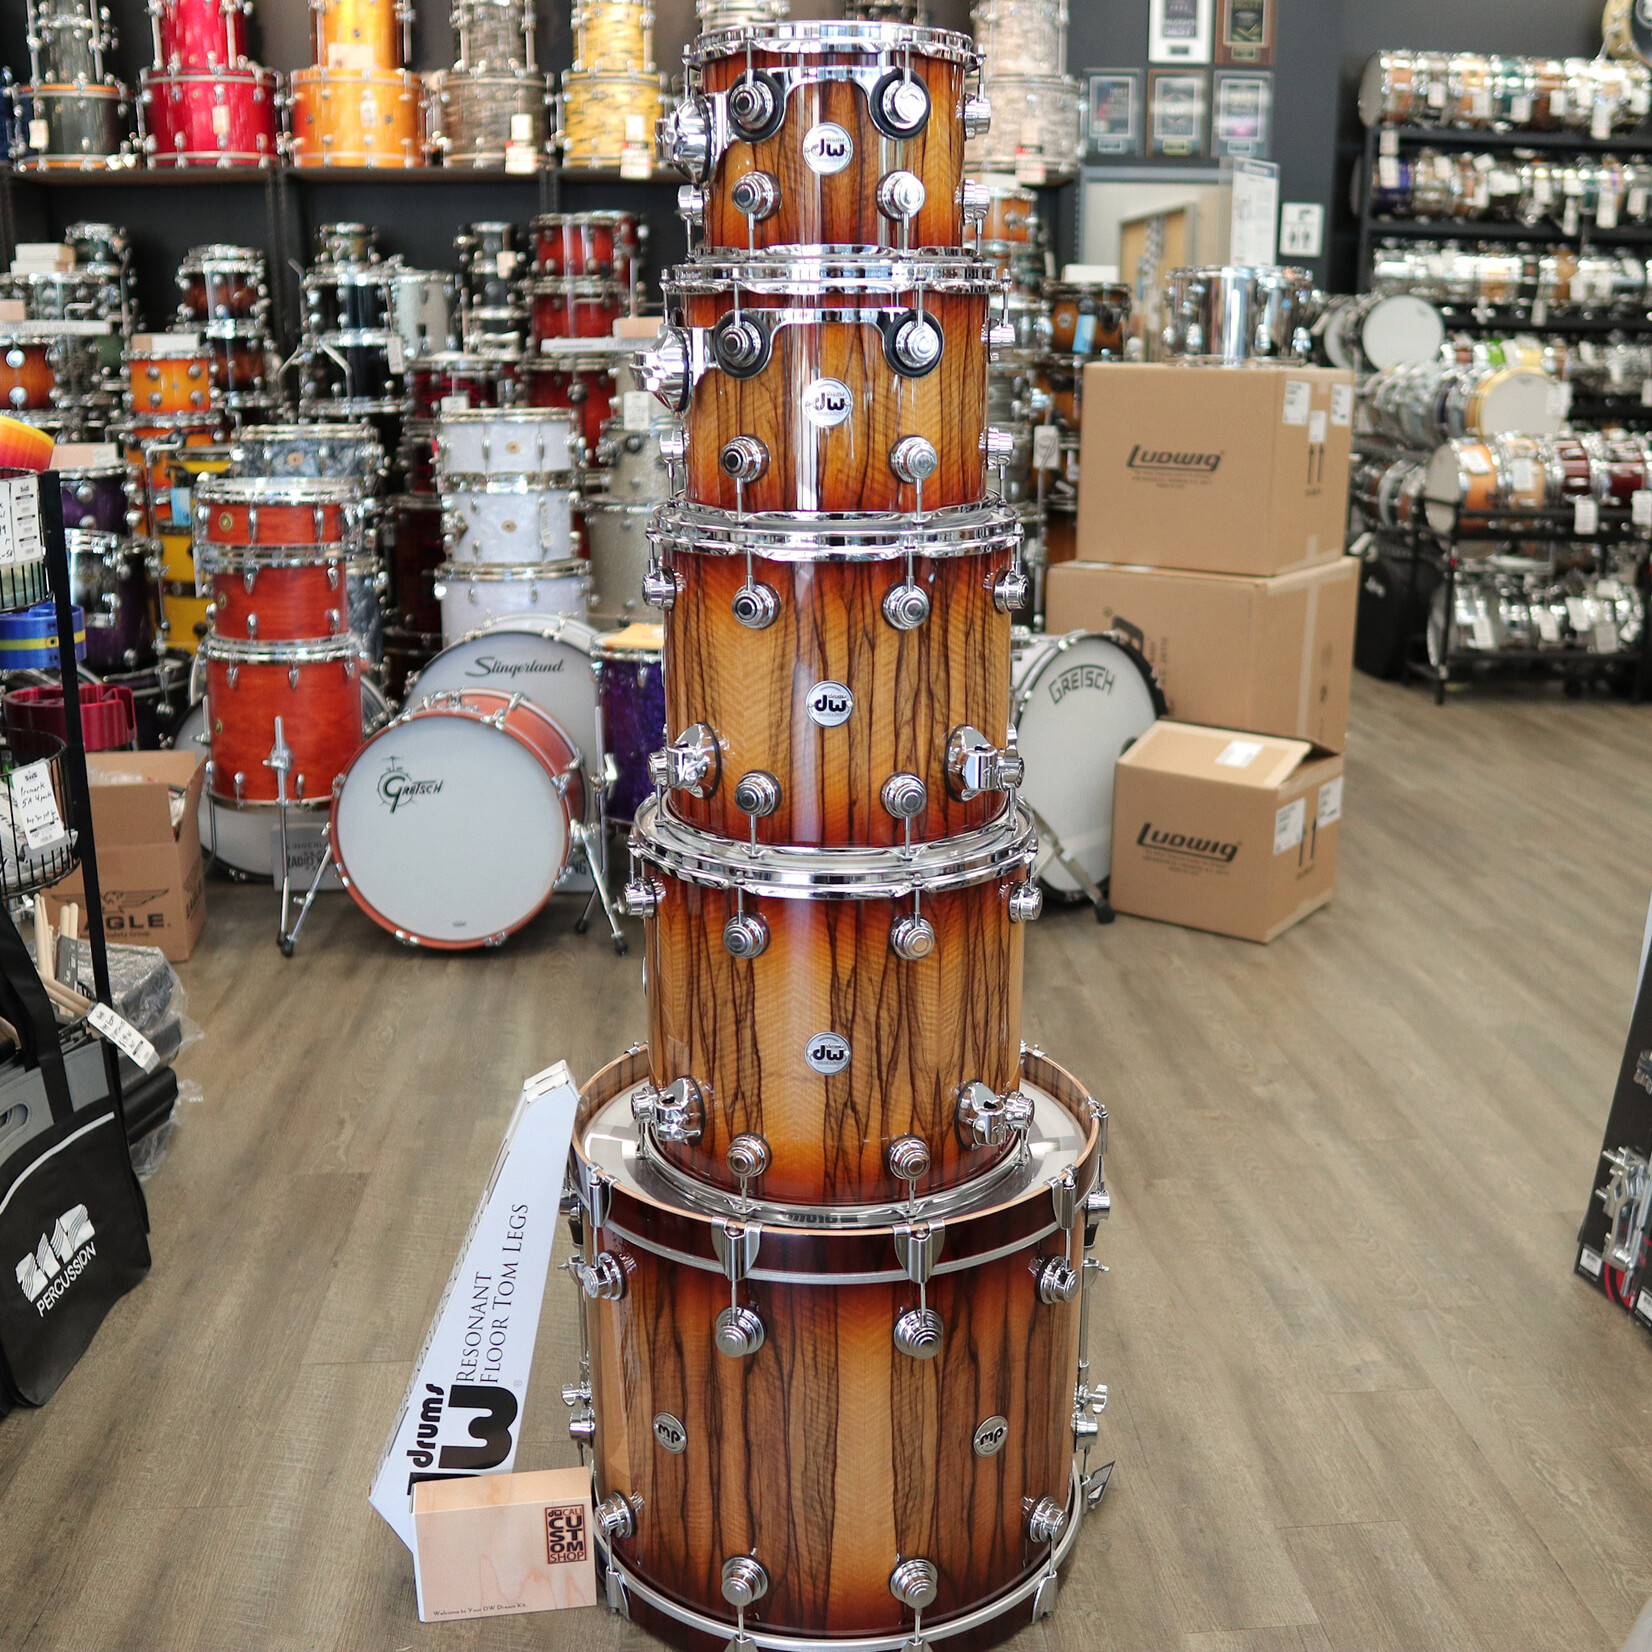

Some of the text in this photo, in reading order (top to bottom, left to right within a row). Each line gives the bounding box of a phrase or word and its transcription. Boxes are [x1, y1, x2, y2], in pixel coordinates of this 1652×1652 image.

[810, 137, 845, 157] dw
[814, 391, 845, 411] dw
[464, 655, 565, 678] Slingerland
[1048, 665, 1115, 705] GRETSCH
[814, 694, 847, 712] dw
[812, 1044, 845, 1061] dw
[36, 1241, 97, 1318] PERCUSSION
[479, 1203, 529, 1384] FLOOR TOM LEGS
[455, 1271, 492, 1383] RESONANT
[406, 1383, 445, 1469] drums
[563, 1508, 583, 1517] CALI
[550, 1551, 585, 1562] SHOP
[482, 1604, 496, 1612] DW
